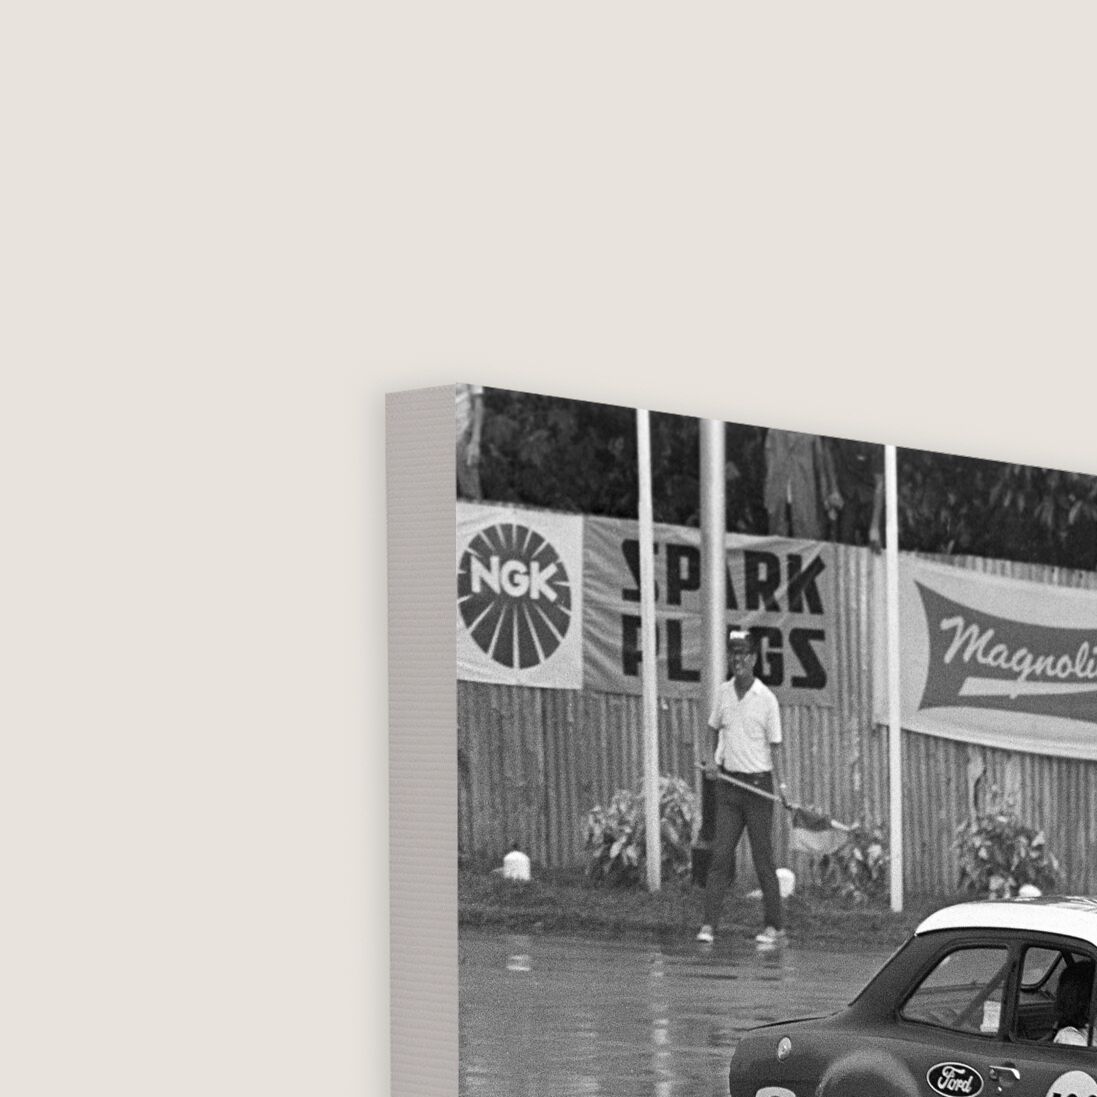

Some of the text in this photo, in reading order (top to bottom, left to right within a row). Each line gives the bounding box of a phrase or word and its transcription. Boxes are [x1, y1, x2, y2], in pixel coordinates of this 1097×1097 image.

[470, 554, 559, 602] NGK
[621, 538, 826, 615] SPRK
[621, 614, 828, 690] PLGS
[937, 1065, 974, 1094] Ford
